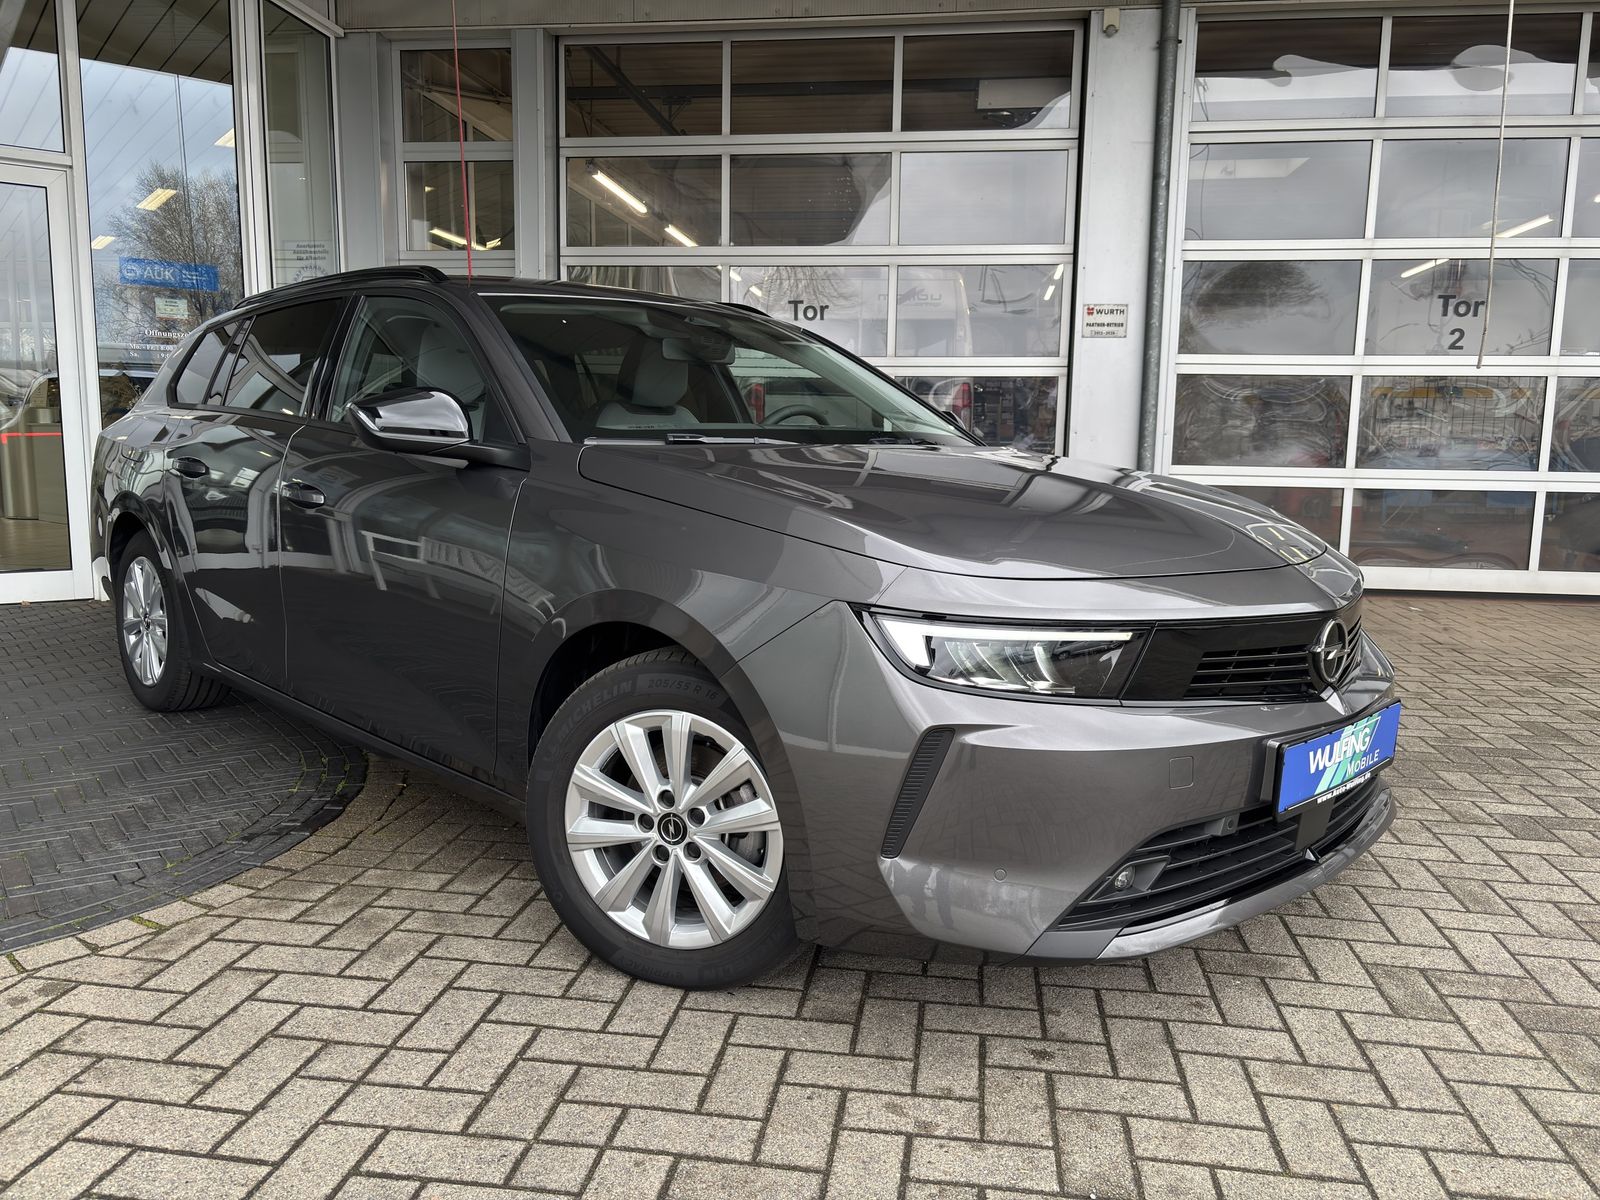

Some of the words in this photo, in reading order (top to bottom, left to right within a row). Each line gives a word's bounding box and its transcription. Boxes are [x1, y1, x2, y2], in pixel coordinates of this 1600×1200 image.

[788, 299, 830, 321] Tor
[1437, 294, 1486, 317] Tor
[1447, 328, 1465, 350] 2
[647, 679, 691, 691] 205/55
[693, 685, 702, 694] R
[705, 689, 720, 700] 16
[557, 680, 633, 741] MICHELIN
[1308, 727, 1371, 775] WULFING
[1346, 748, 1380, 777] MOBILE
